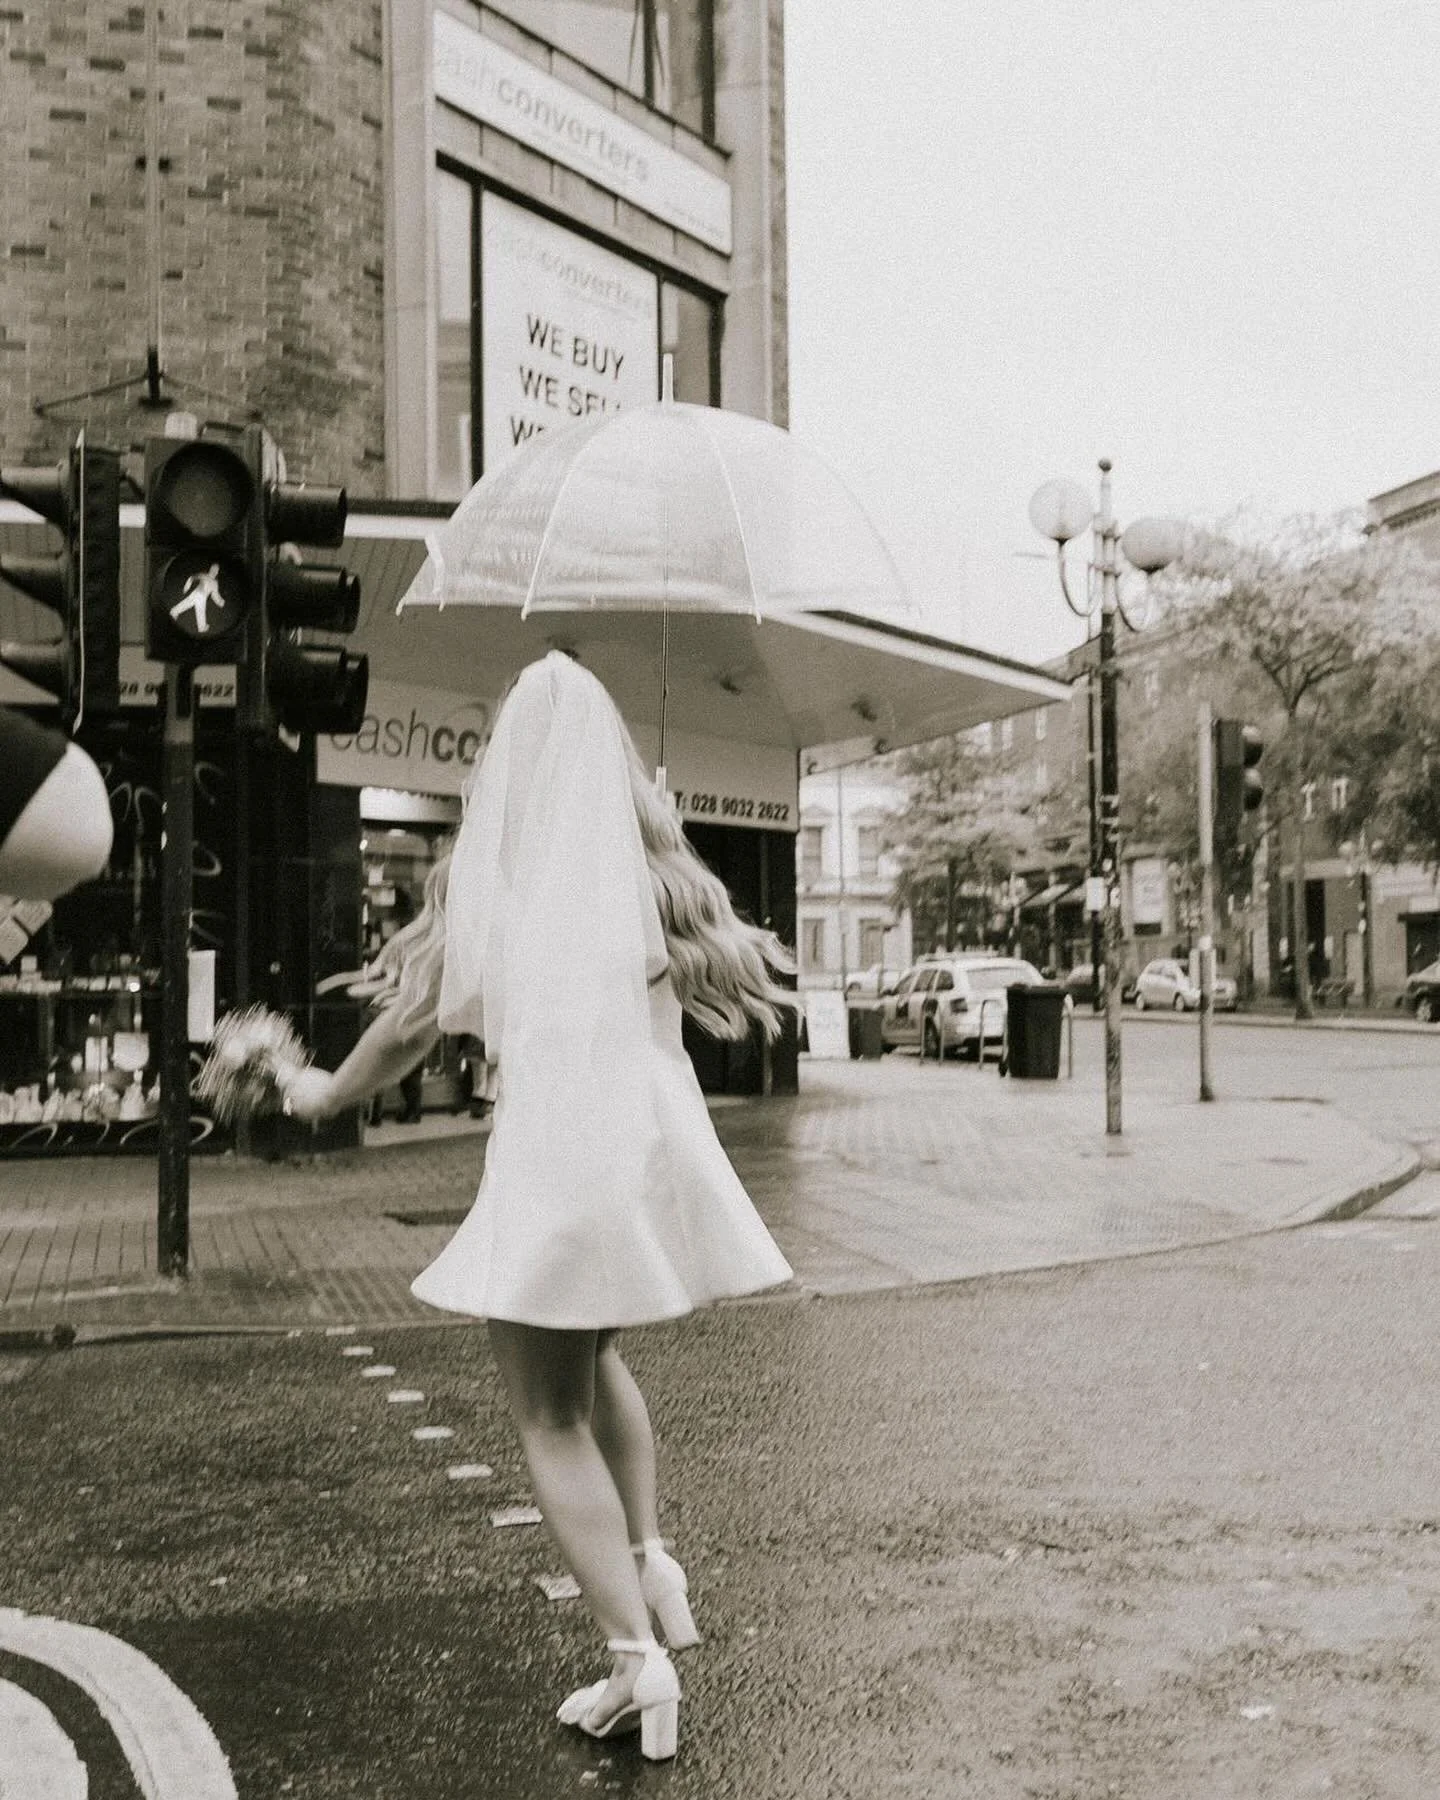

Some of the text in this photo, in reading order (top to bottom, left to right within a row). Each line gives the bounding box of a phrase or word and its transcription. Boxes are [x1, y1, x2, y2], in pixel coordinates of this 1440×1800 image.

[527, 313, 625, 380] WE BUY
[519, 364, 621, 417] WE SE
[510, 414, 546, 447] W
[691, 793, 717, 814] 028
[721, 796, 755, 818] 9032
[757, 801, 790, 821] 2622
